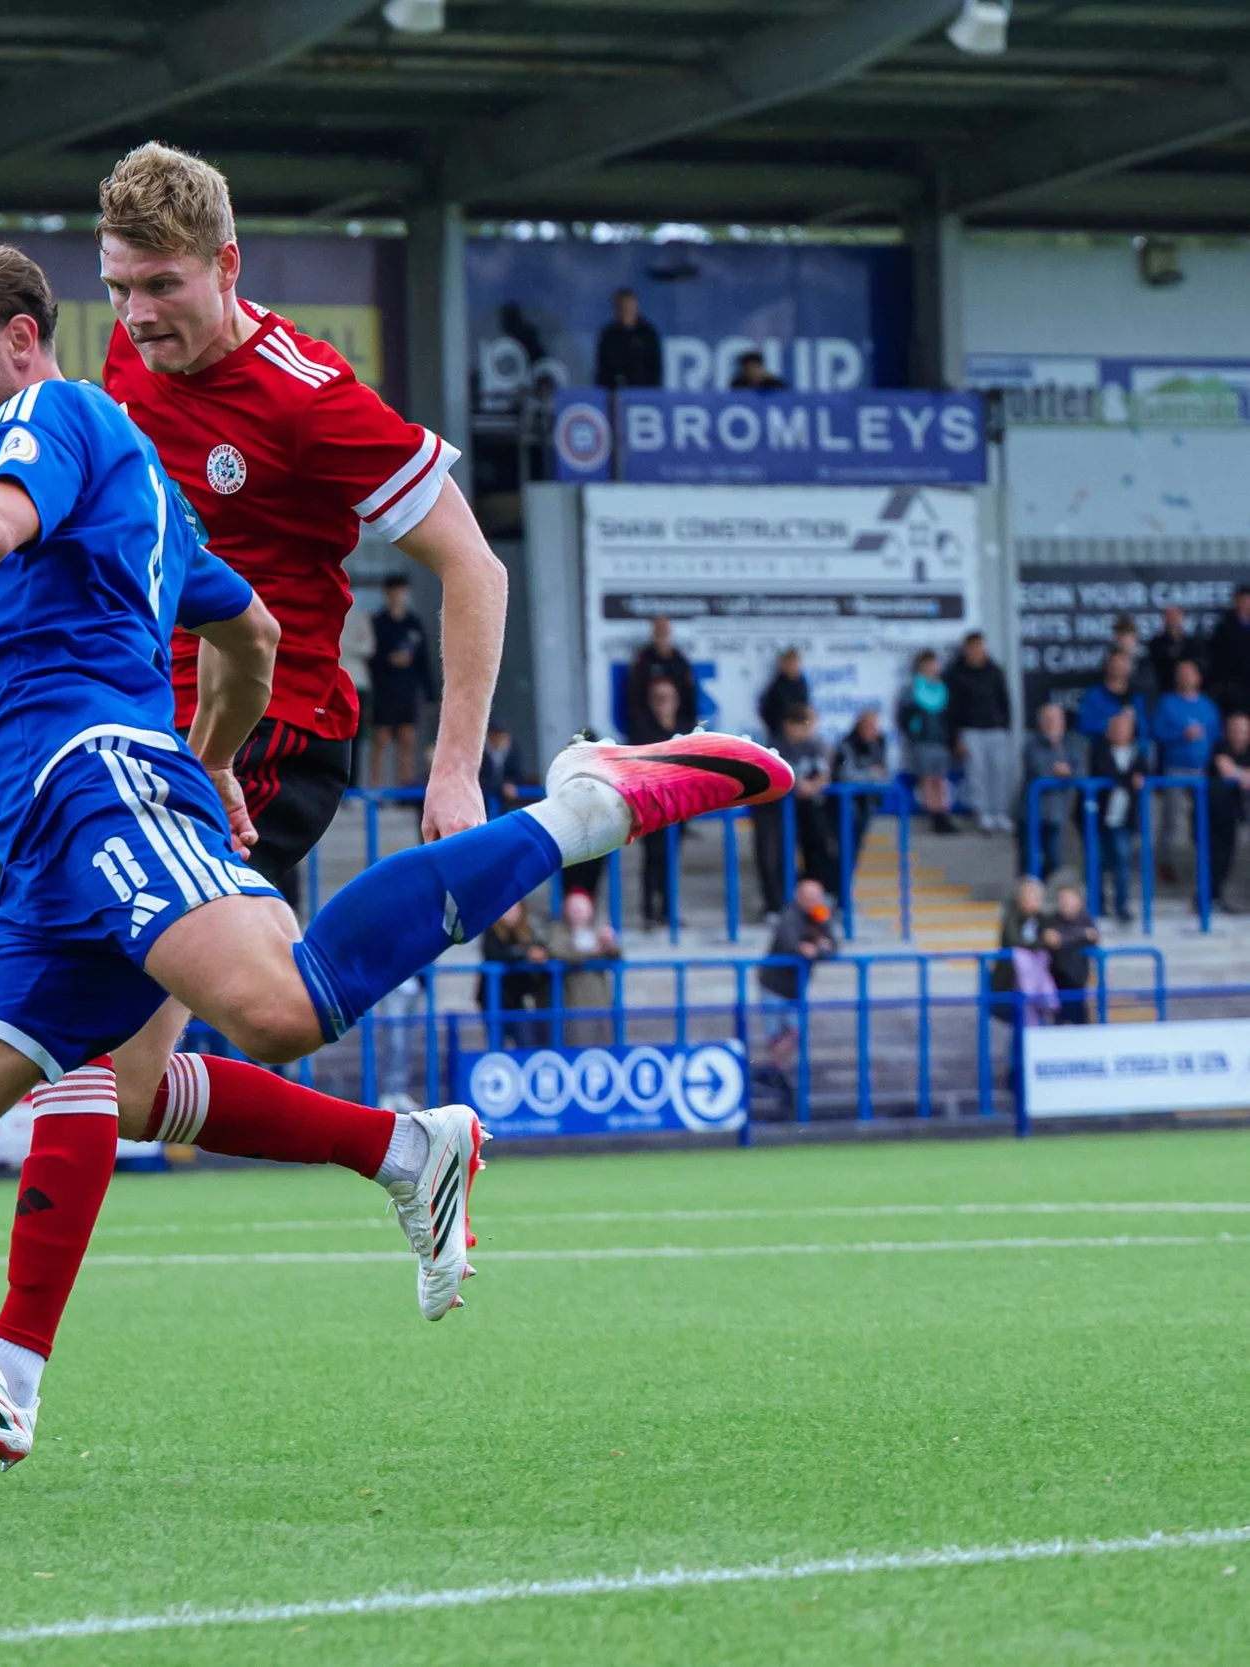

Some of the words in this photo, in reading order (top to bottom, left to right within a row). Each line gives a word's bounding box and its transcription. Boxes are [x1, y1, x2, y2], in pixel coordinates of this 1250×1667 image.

[661, 336, 865, 394] ROUP
[626, 403, 979, 454] BROMLEYS
[673, 515, 849, 542] CONSTRUCTION
[1077, 581, 1149, 609] YOUR
[1150, 580, 1236, 609] CAREE
[91, 835, 150, 903] 11
